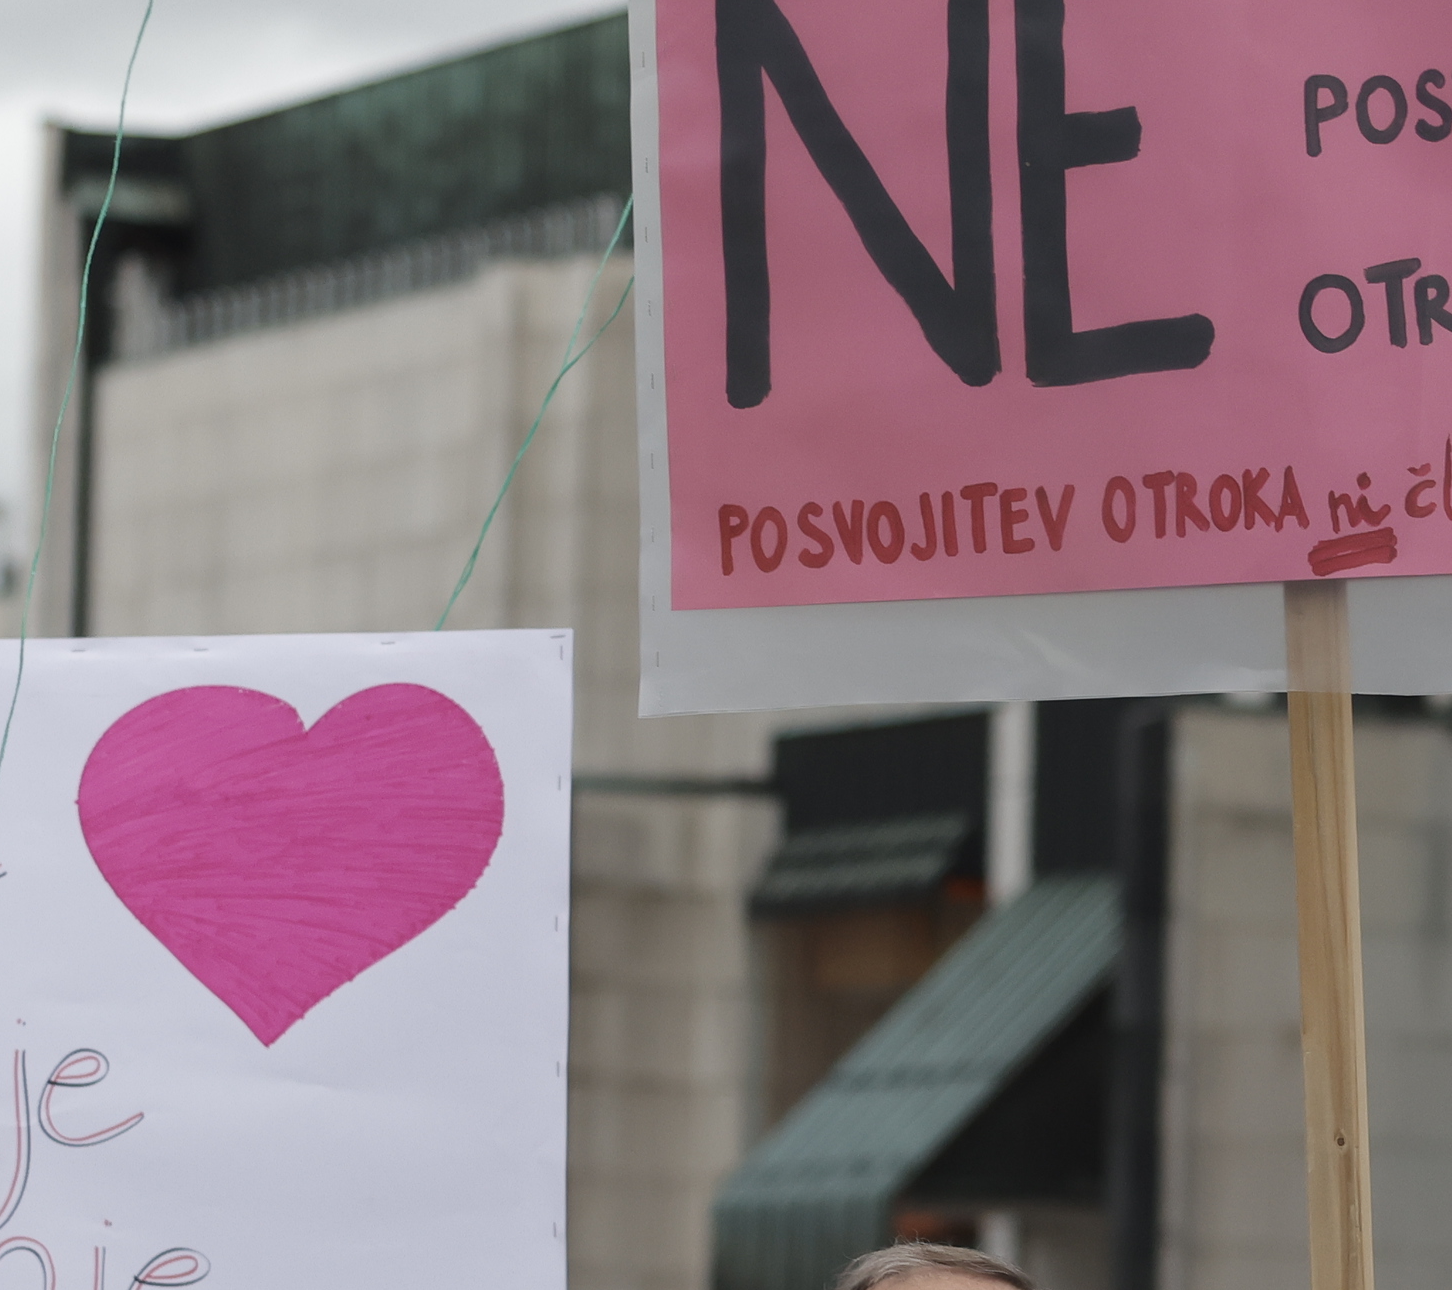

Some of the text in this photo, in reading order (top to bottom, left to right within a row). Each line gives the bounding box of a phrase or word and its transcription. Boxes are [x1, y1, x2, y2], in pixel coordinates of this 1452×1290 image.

[719, 479, 1075, 575] POSVOJITEV
[1102, 464, 1310, 544] OTROKA
[1328, 472, 1391, 534] ni
